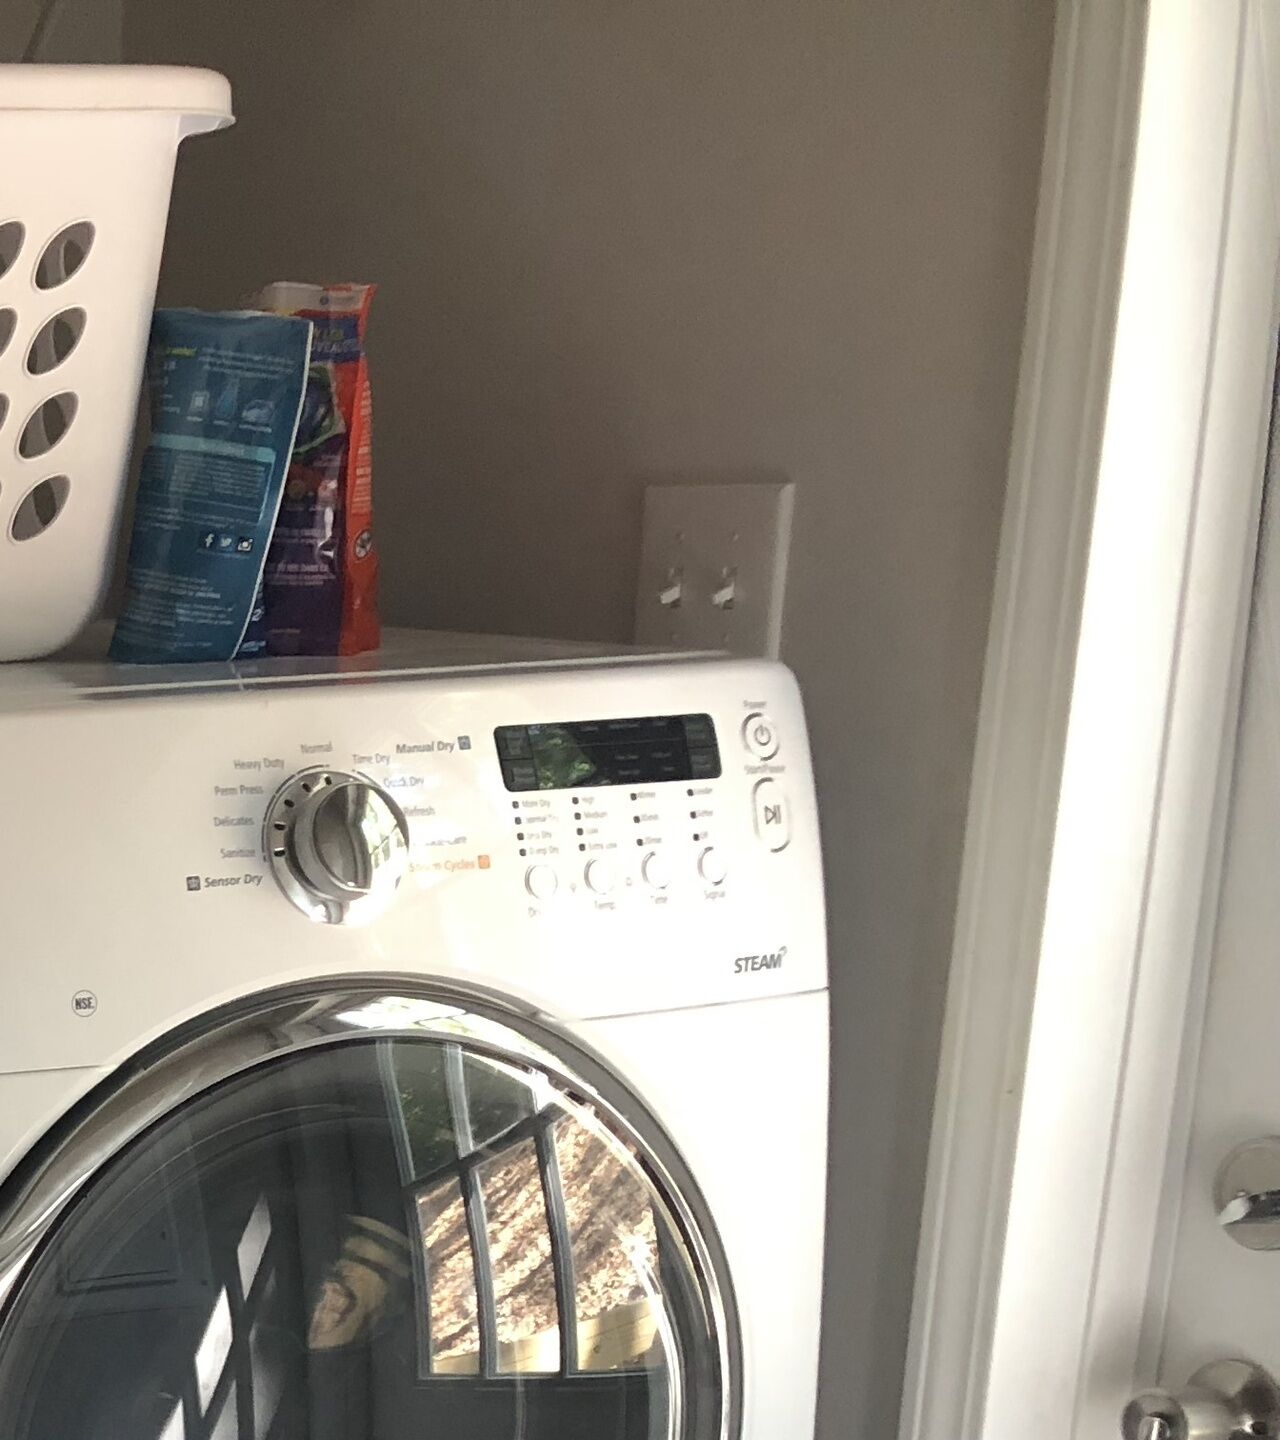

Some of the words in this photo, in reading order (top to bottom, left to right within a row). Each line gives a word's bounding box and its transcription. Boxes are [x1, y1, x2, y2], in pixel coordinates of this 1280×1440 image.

[301, 741, 333, 753] Normal
[396, 742, 435, 753] Manual
[437, 740, 455, 753] Dry
[234, 760, 261, 771] Heavy
[263, 758, 284, 769] Duty
[352, 754, 372, 764] Time
[375, 752, 390, 765] Dry
[214, 786, 238, 796] Perm
[240, 784, 263, 795] Press
[213, 817, 255, 827] Delicates
[205, 876, 241, 888] Sensor
[244, 874, 263, 886] Dry
[734, 953, 782, 973] STEAM
